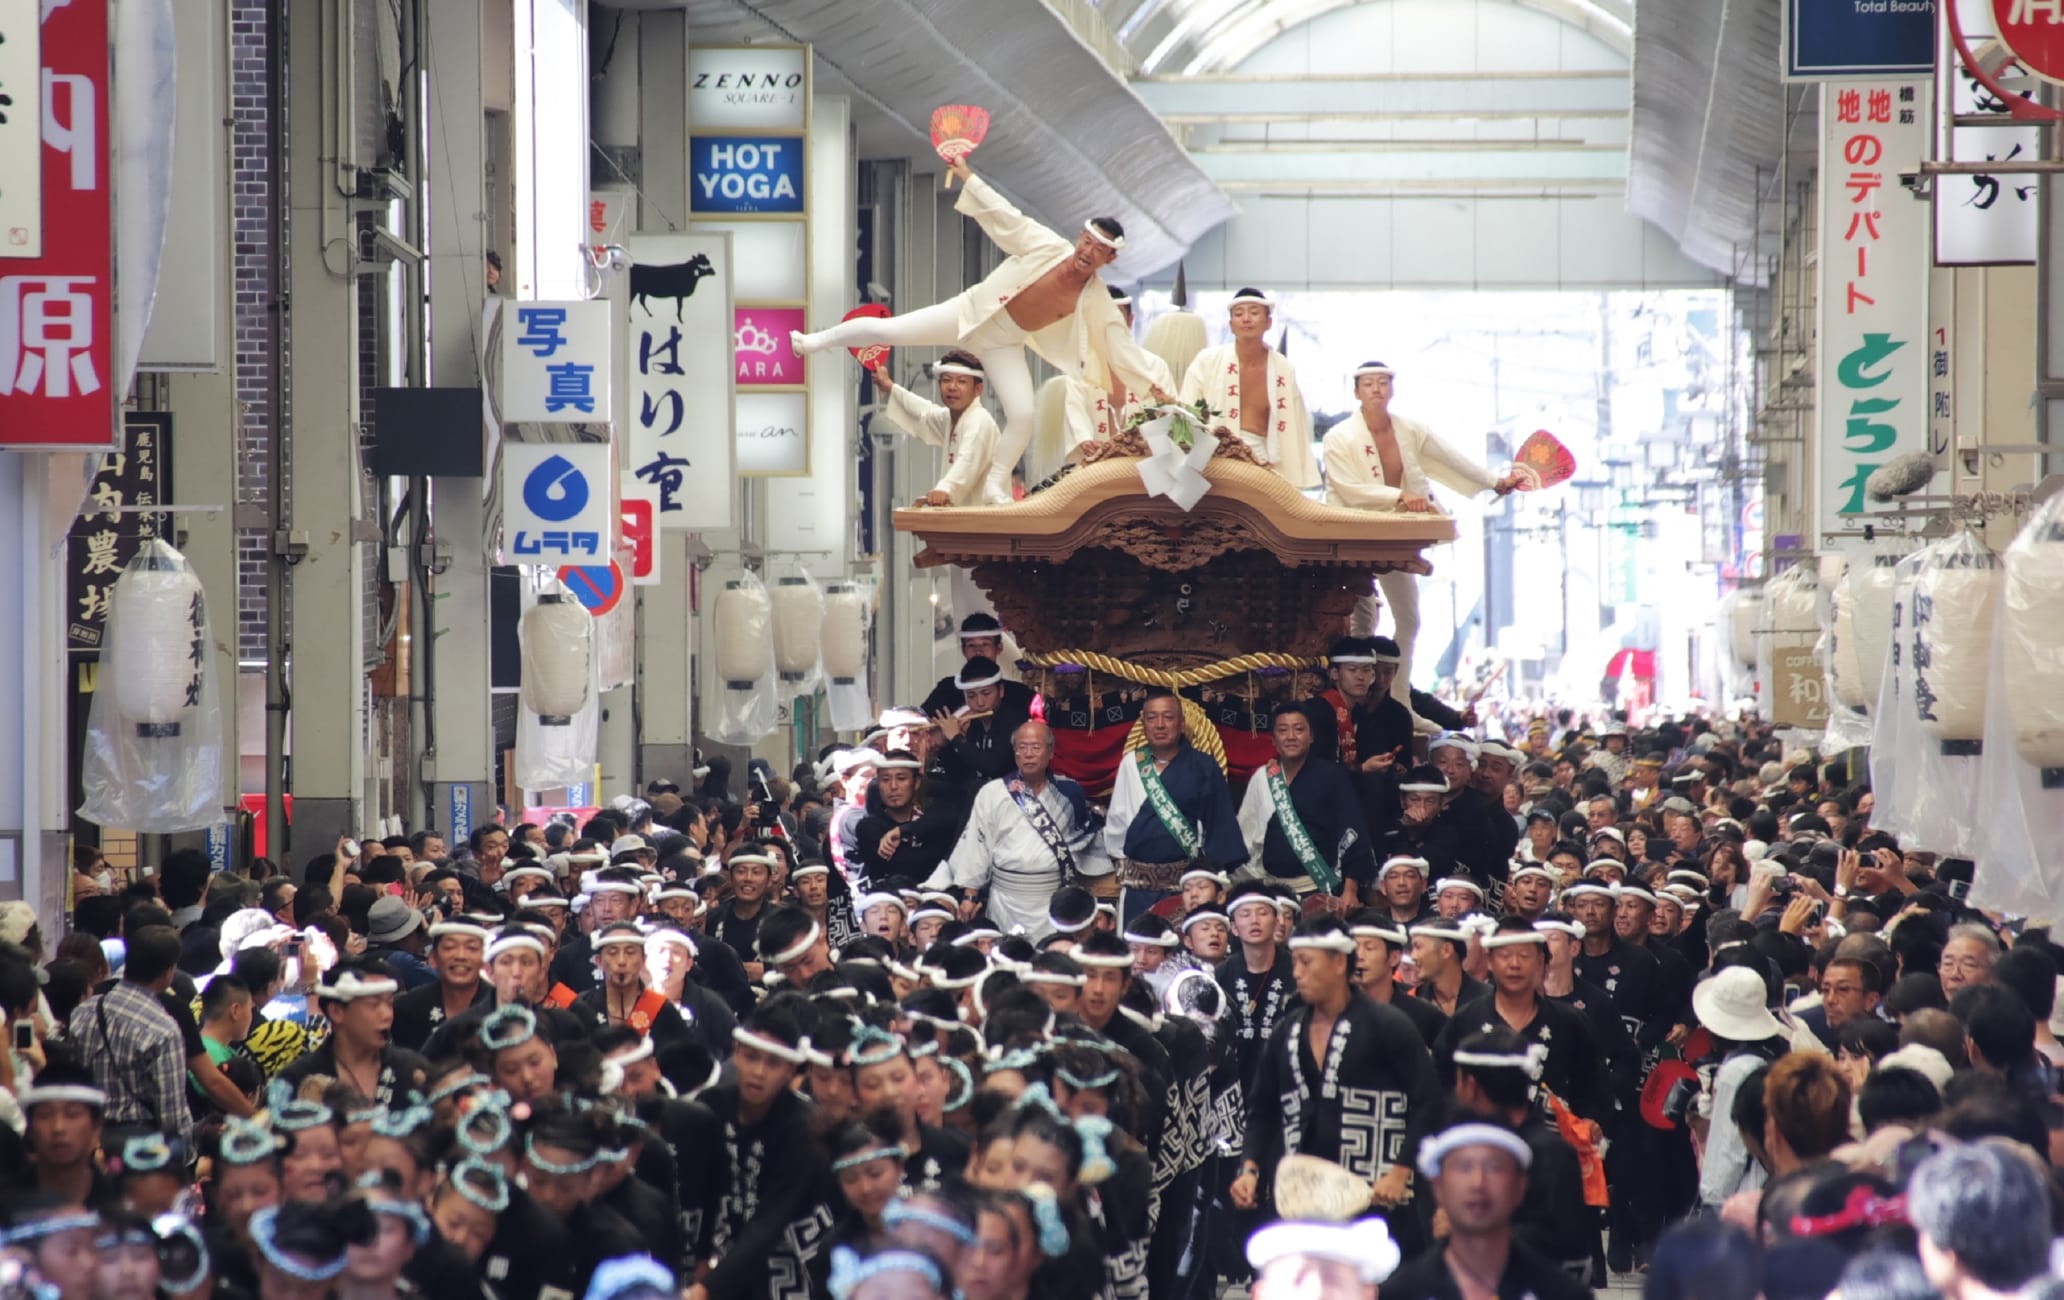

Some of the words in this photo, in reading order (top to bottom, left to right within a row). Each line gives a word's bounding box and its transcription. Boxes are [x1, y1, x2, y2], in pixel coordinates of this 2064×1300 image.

[1854, 0, 1887, 13] Total
[1890, 0, 1937, 14] Beauty
[693, 73, 803, 90] ZENNO
[711, 143, 782, 170] HOT
[698, 173, 796, 200] YOGA
[517, 308, 595, 414] 写真
[635, 325, 691, 512] はり重
[513, 530, 599, 556] ムラタ
